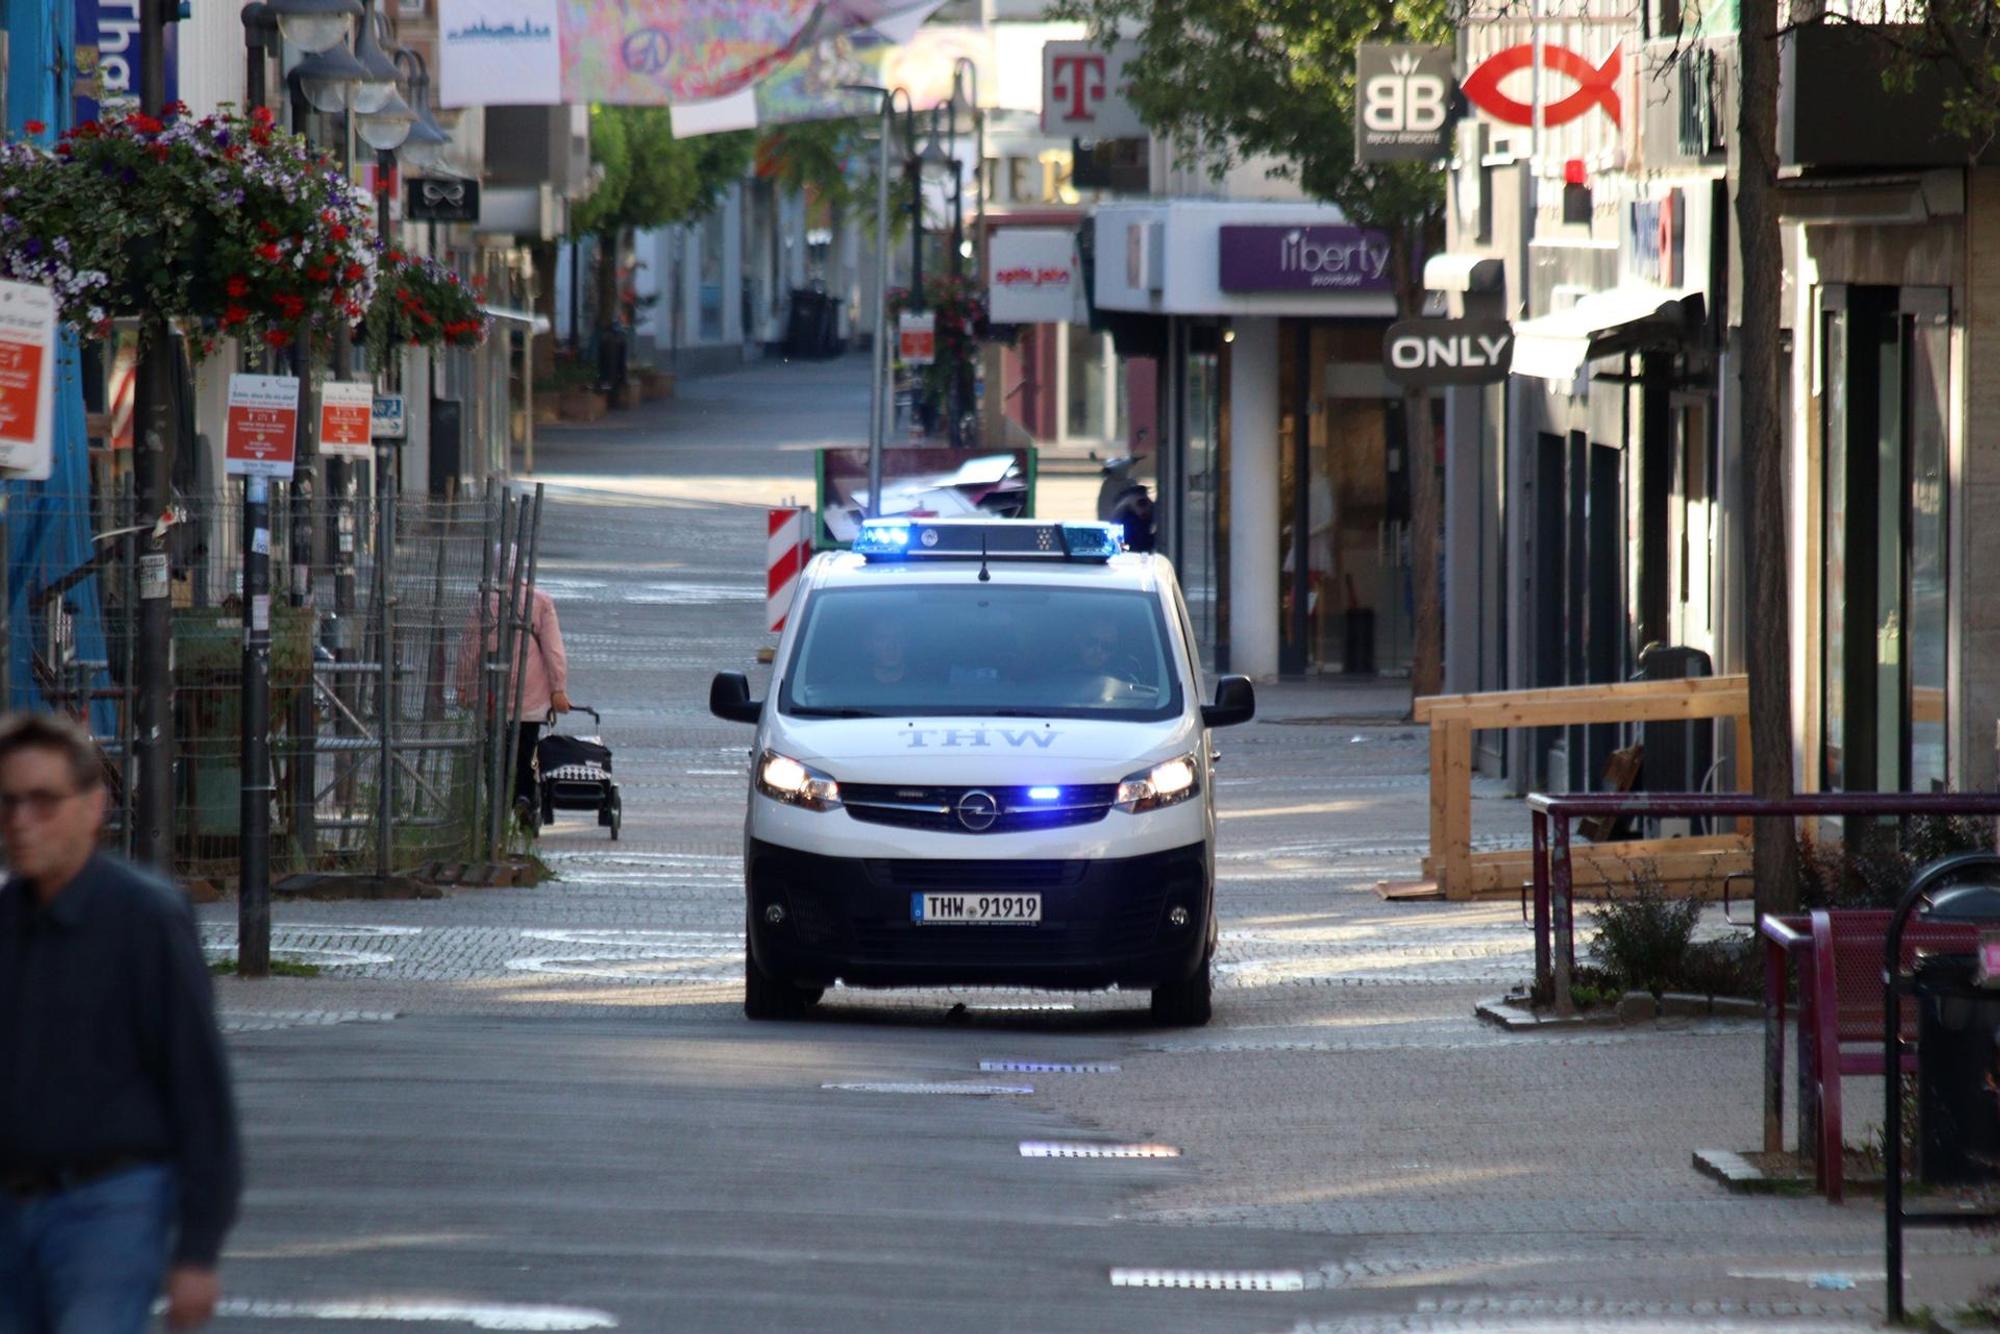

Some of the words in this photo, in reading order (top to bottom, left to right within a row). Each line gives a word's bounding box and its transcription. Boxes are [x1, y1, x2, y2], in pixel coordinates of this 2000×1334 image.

[1053, 55, 1106, 122] T
[1281, 230, 1392, 279] liberty
[1391, 335, 1509, 369] ONLY
[898, 729, 1065, 749] THW
[928, 897, 965, 917] THW
[979, 897, 1037, 918] 91919
